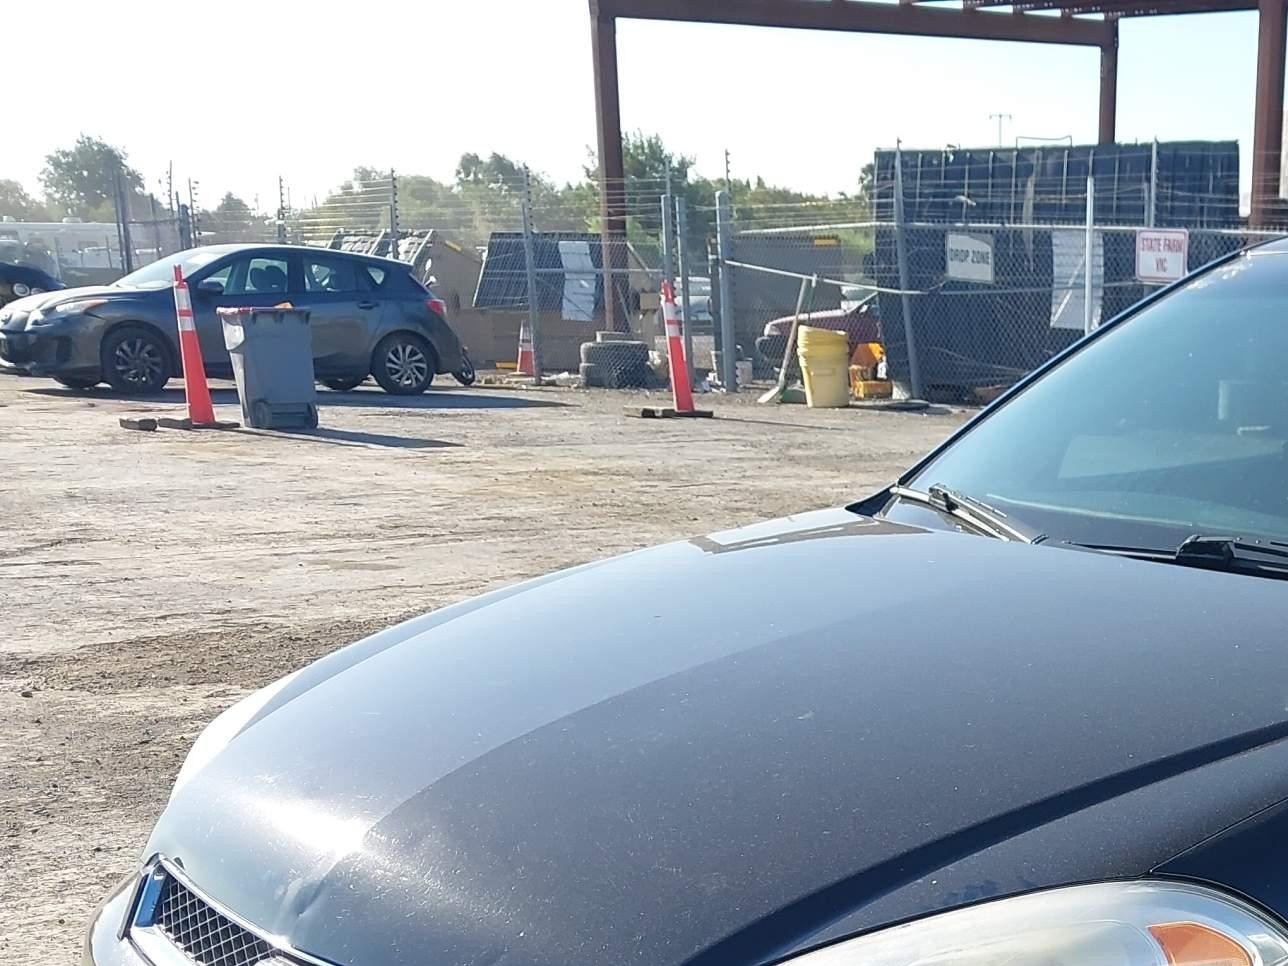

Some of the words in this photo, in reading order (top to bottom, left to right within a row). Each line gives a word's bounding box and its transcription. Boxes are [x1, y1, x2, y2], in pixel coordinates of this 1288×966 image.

[1141, 237, 1161, 251] STATE
[1163, 238, 1184, 253] FARM
[949, 248, 970, 263] DROP
[971, 249, 990, 265] ZONE
